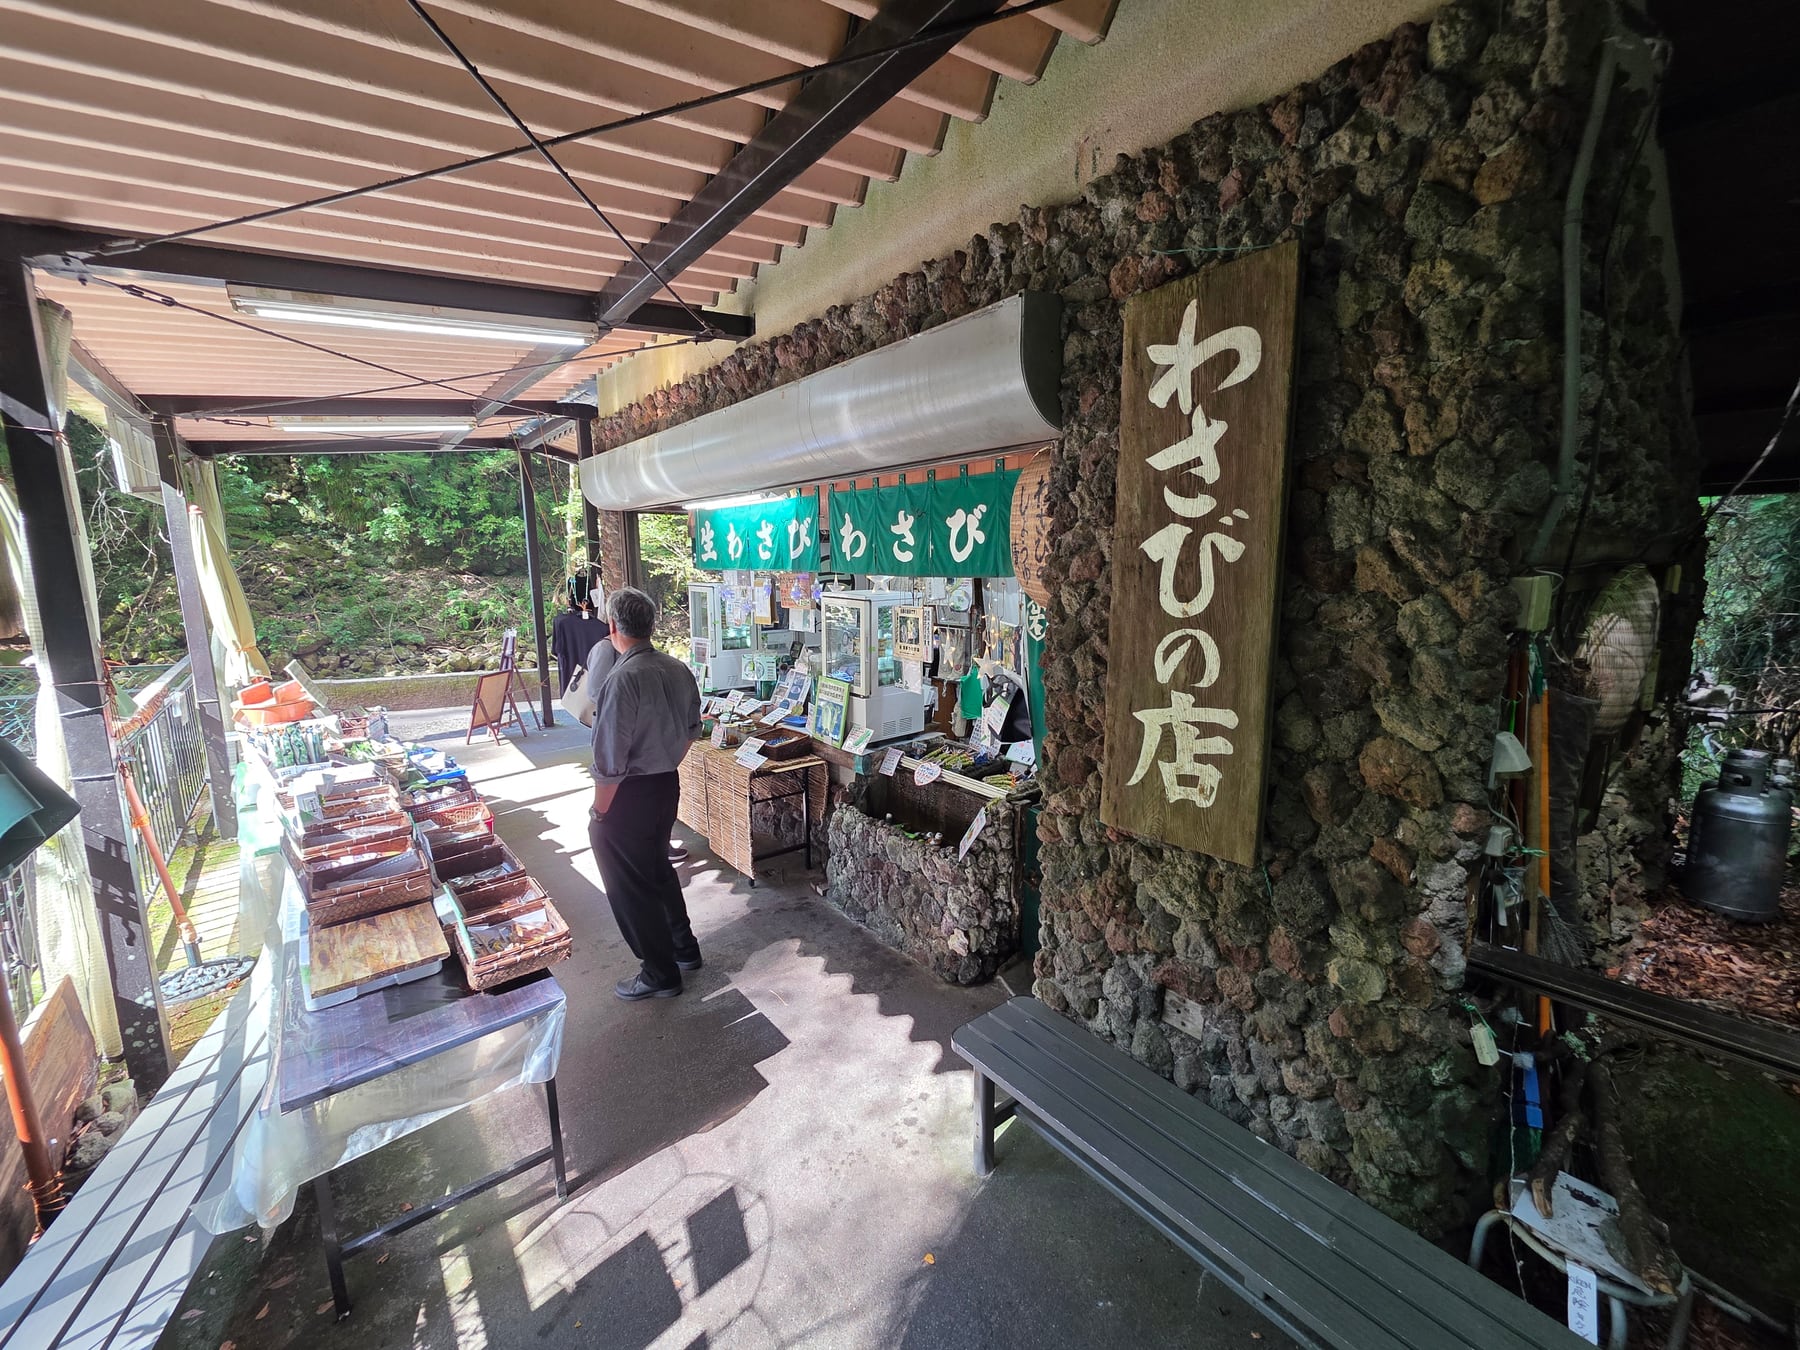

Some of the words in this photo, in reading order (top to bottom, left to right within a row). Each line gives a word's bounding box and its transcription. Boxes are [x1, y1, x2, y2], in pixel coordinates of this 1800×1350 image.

[700, 517, 811, 562] 生わさび
[839, 504, 987, 564] わさび
[1126, 299, 1262, 808] わさびの店
